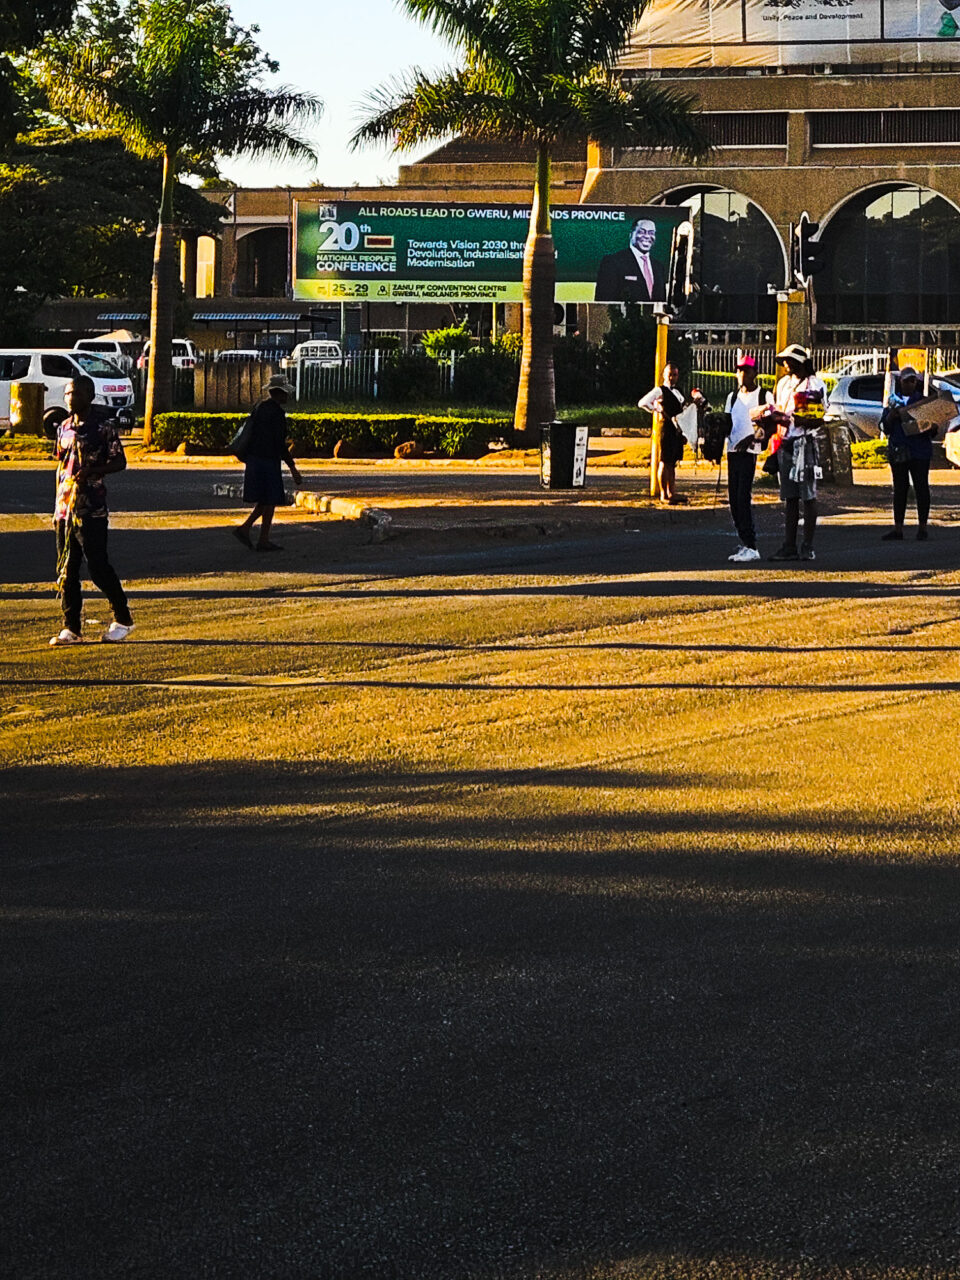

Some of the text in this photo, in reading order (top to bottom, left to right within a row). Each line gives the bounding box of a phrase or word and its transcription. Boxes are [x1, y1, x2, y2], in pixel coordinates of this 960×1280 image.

[819, 12, 864, 21] Development
[358, 207, 378, 216] ALL
[380, 207, 418, 217] ROADS
[420, 208, 448, 217] LEAD
[450, 208, 465, 218] TO
[467, 209, 511, 220] GWERU,
[571, 210, 626, 220] PROVINCE
[407, 239, 448, 249] Towards
[450, 239, 480, 249] Vision
[482, 240, 508, 249] 2030
[316, 254, 357, 262] NATIONAL
[407, 248, 462, 259] Devolution,
[316, 261, 397, 272] CONFERENCE
[406, 258, 475, 268] Modernisation
[332, 283, 346, 292] 25
[355, 283, 369, 292] 29
[427, 284, 476, 292] CONVENTION
